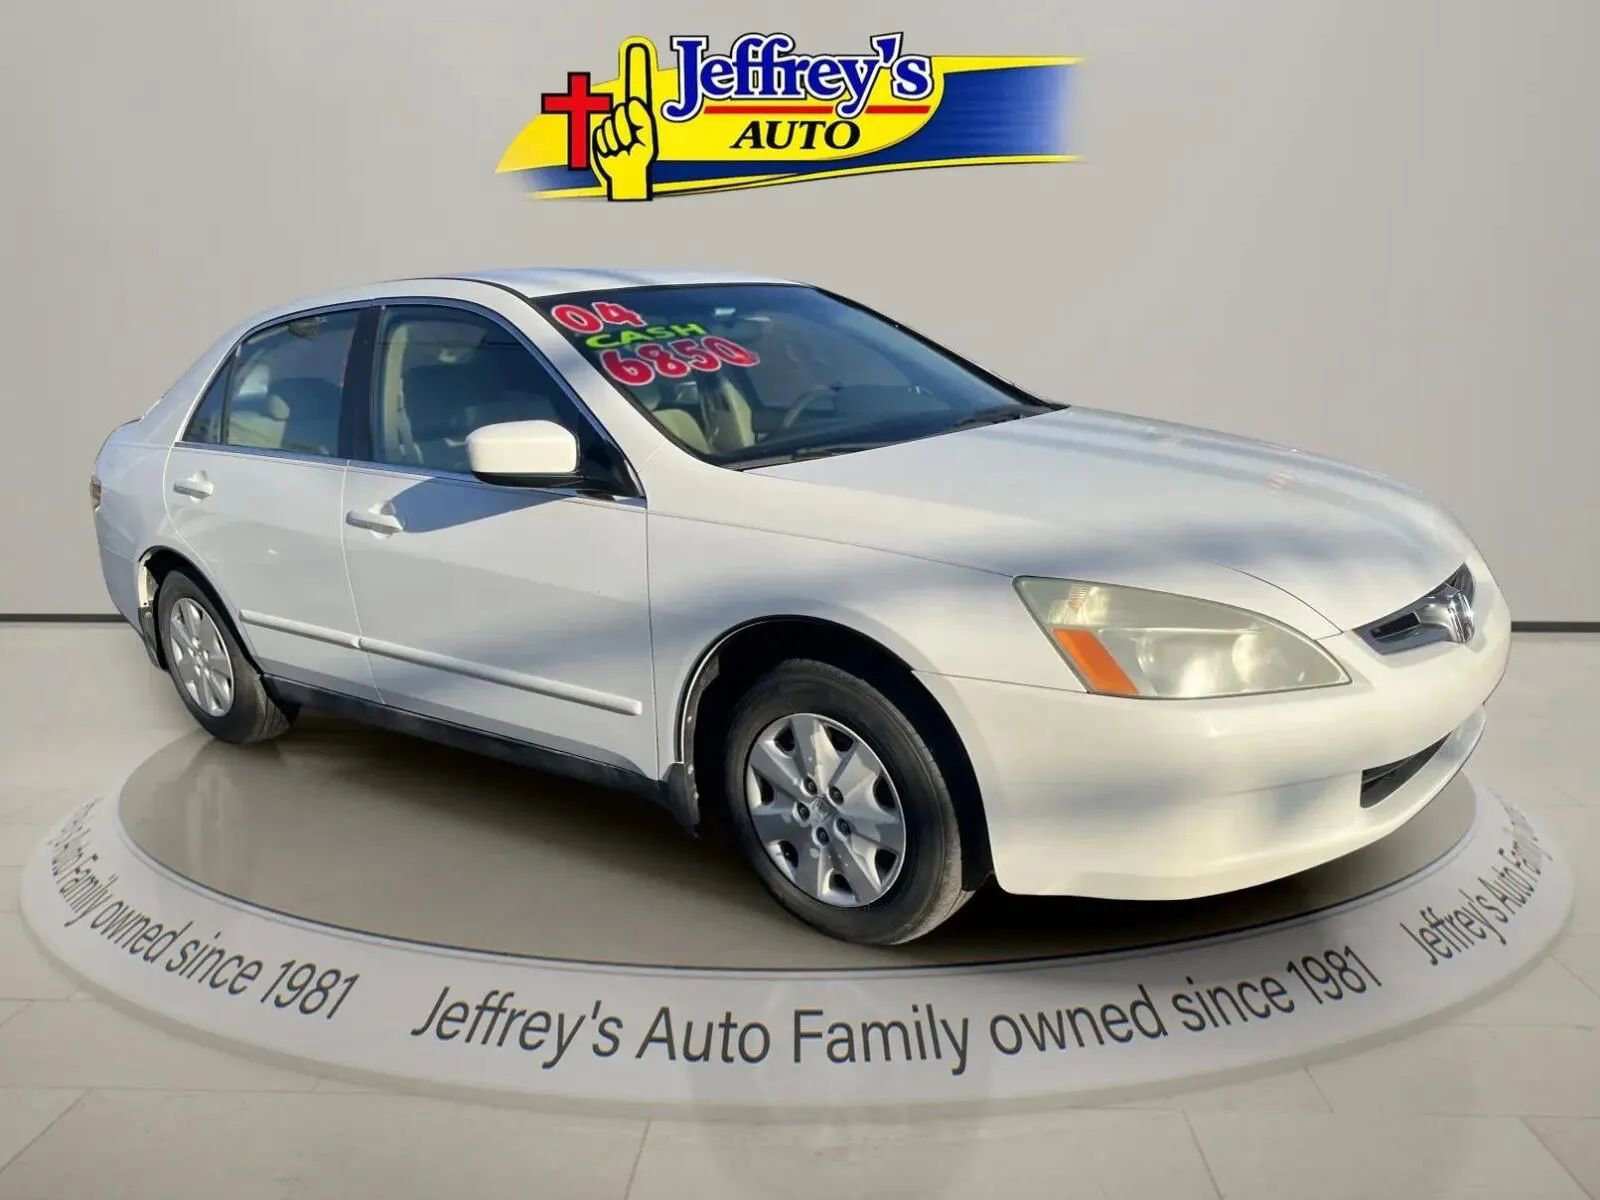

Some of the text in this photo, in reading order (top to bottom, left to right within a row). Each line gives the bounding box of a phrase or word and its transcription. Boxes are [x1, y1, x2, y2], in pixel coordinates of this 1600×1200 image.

[663, 33, 932, 120] Jeffrey's
[729, 120, 860, 150] AUTO
[551, 302, 647, 334] 04
[585, 323, 706, 348] CASH
[600, 336, 760, 386] 6850
[1400, 888, 1509, 966] Jeffrey's
[90, 900, 193, 964] owned
[165, 931, 263, 995] since
[260, 959, 360, 1020] 1981
[411, 945, 1382, 1076] Jeffrey's Auto Family owned since 1981
